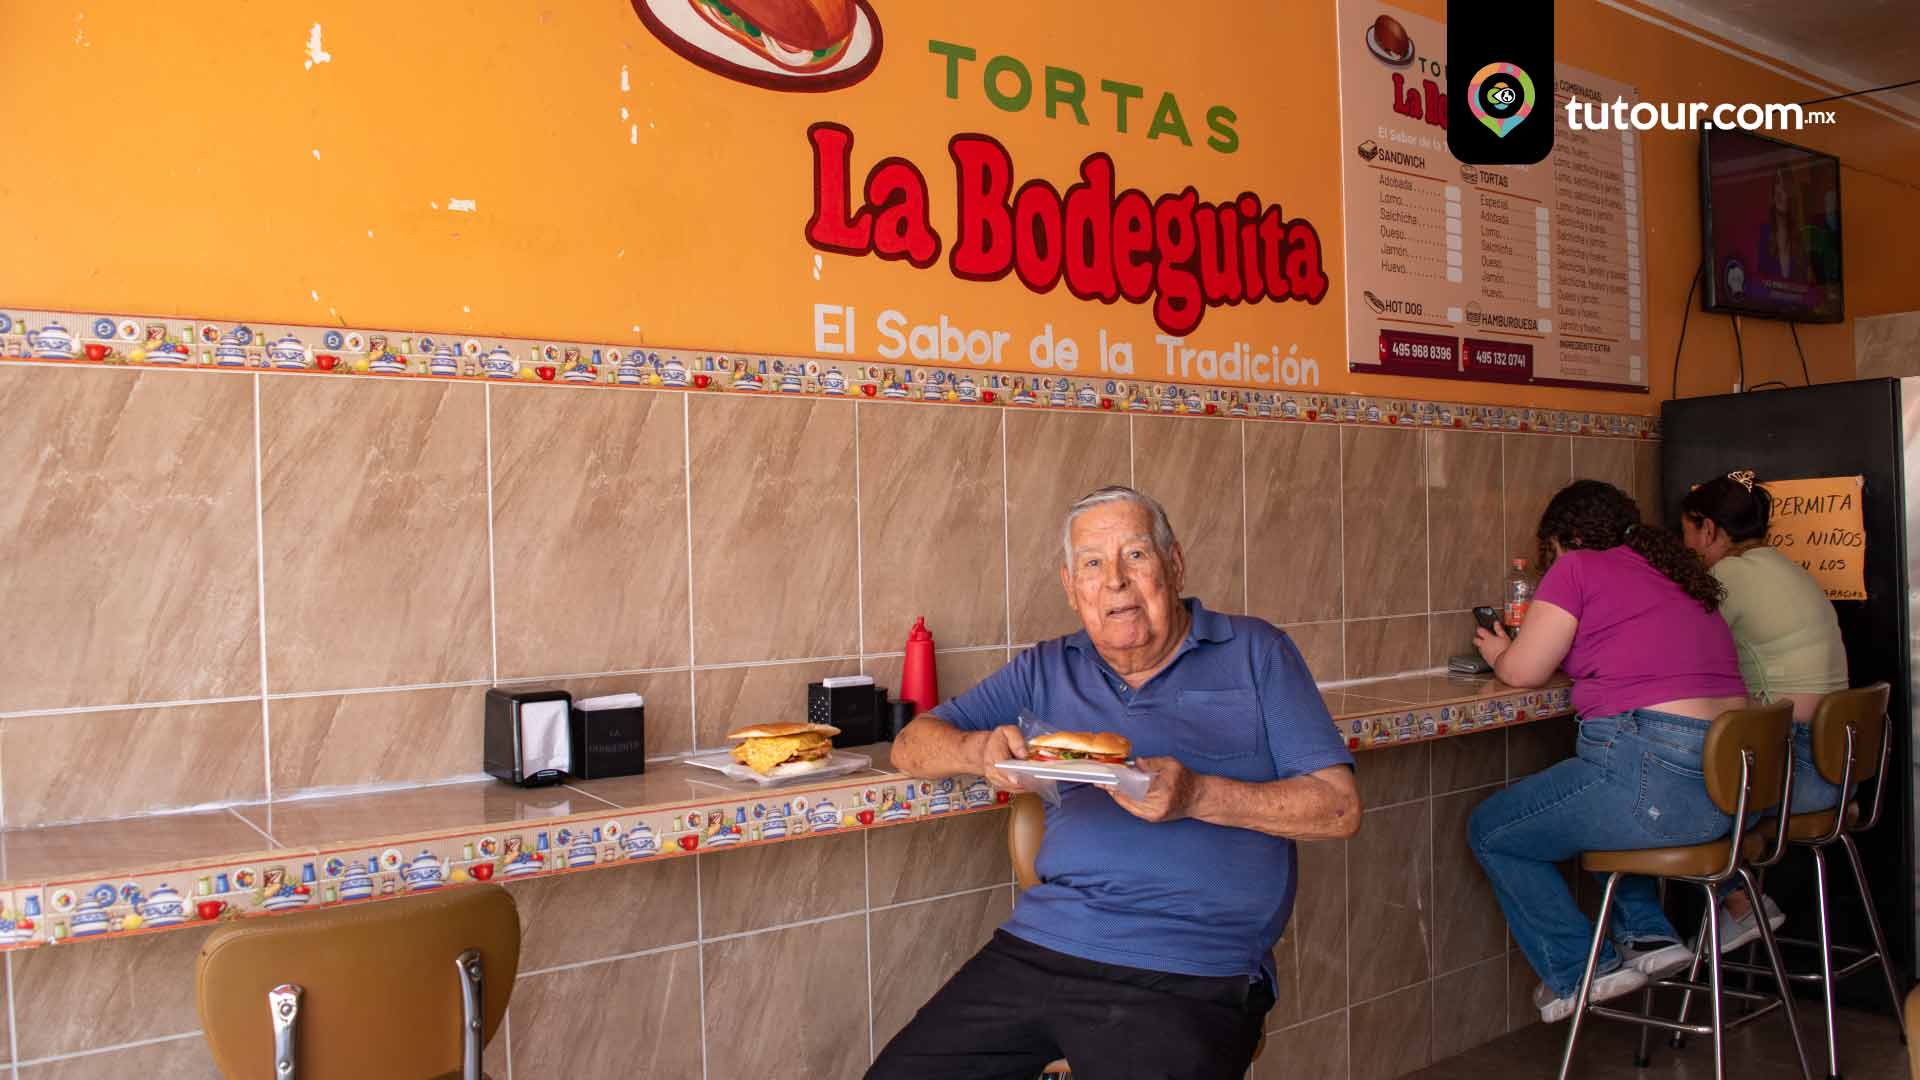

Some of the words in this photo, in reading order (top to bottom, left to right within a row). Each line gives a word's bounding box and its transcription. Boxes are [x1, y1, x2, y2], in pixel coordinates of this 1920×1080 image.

[928, 39, 1240, 155] TORTAS
[1392, 72, 1424, 121] La
[1379, 148, 1425, 169] SANDWICH
[1480, 170, 1509, 188] TORTAS
[805, 121, 942, 269] La
[947, 132, 1329, 337] Bodeguita
[1385, 299, 1403, 313] HOT
[1405, 302, 1423, 316] DOG
[1481, 315, 1538, 331] HAMBURGUESA
[813, 303, 856, 355] El
[876, 309, 1011, 364] Sabor
[1029, 323, 1079, 372] de
[1099, 329, 1135, 375] la
[1155, 334, 1320, 387] Tradición
[1392, 342, 1409, 357] 495
[1411, 344, 1429, 359] 968
[1430, 346, 1452, 361] 8396
[1476, 350, 1492, 365] 495
[1494, 352, 1507, 366] 132
[1508, 354, 1526, 368] 0741
[1771, 494, 1852, 518] PERMITA
[1806, 528, 1863, 548] NIÑOS
[1819, 559, 1847, 571] LOS
